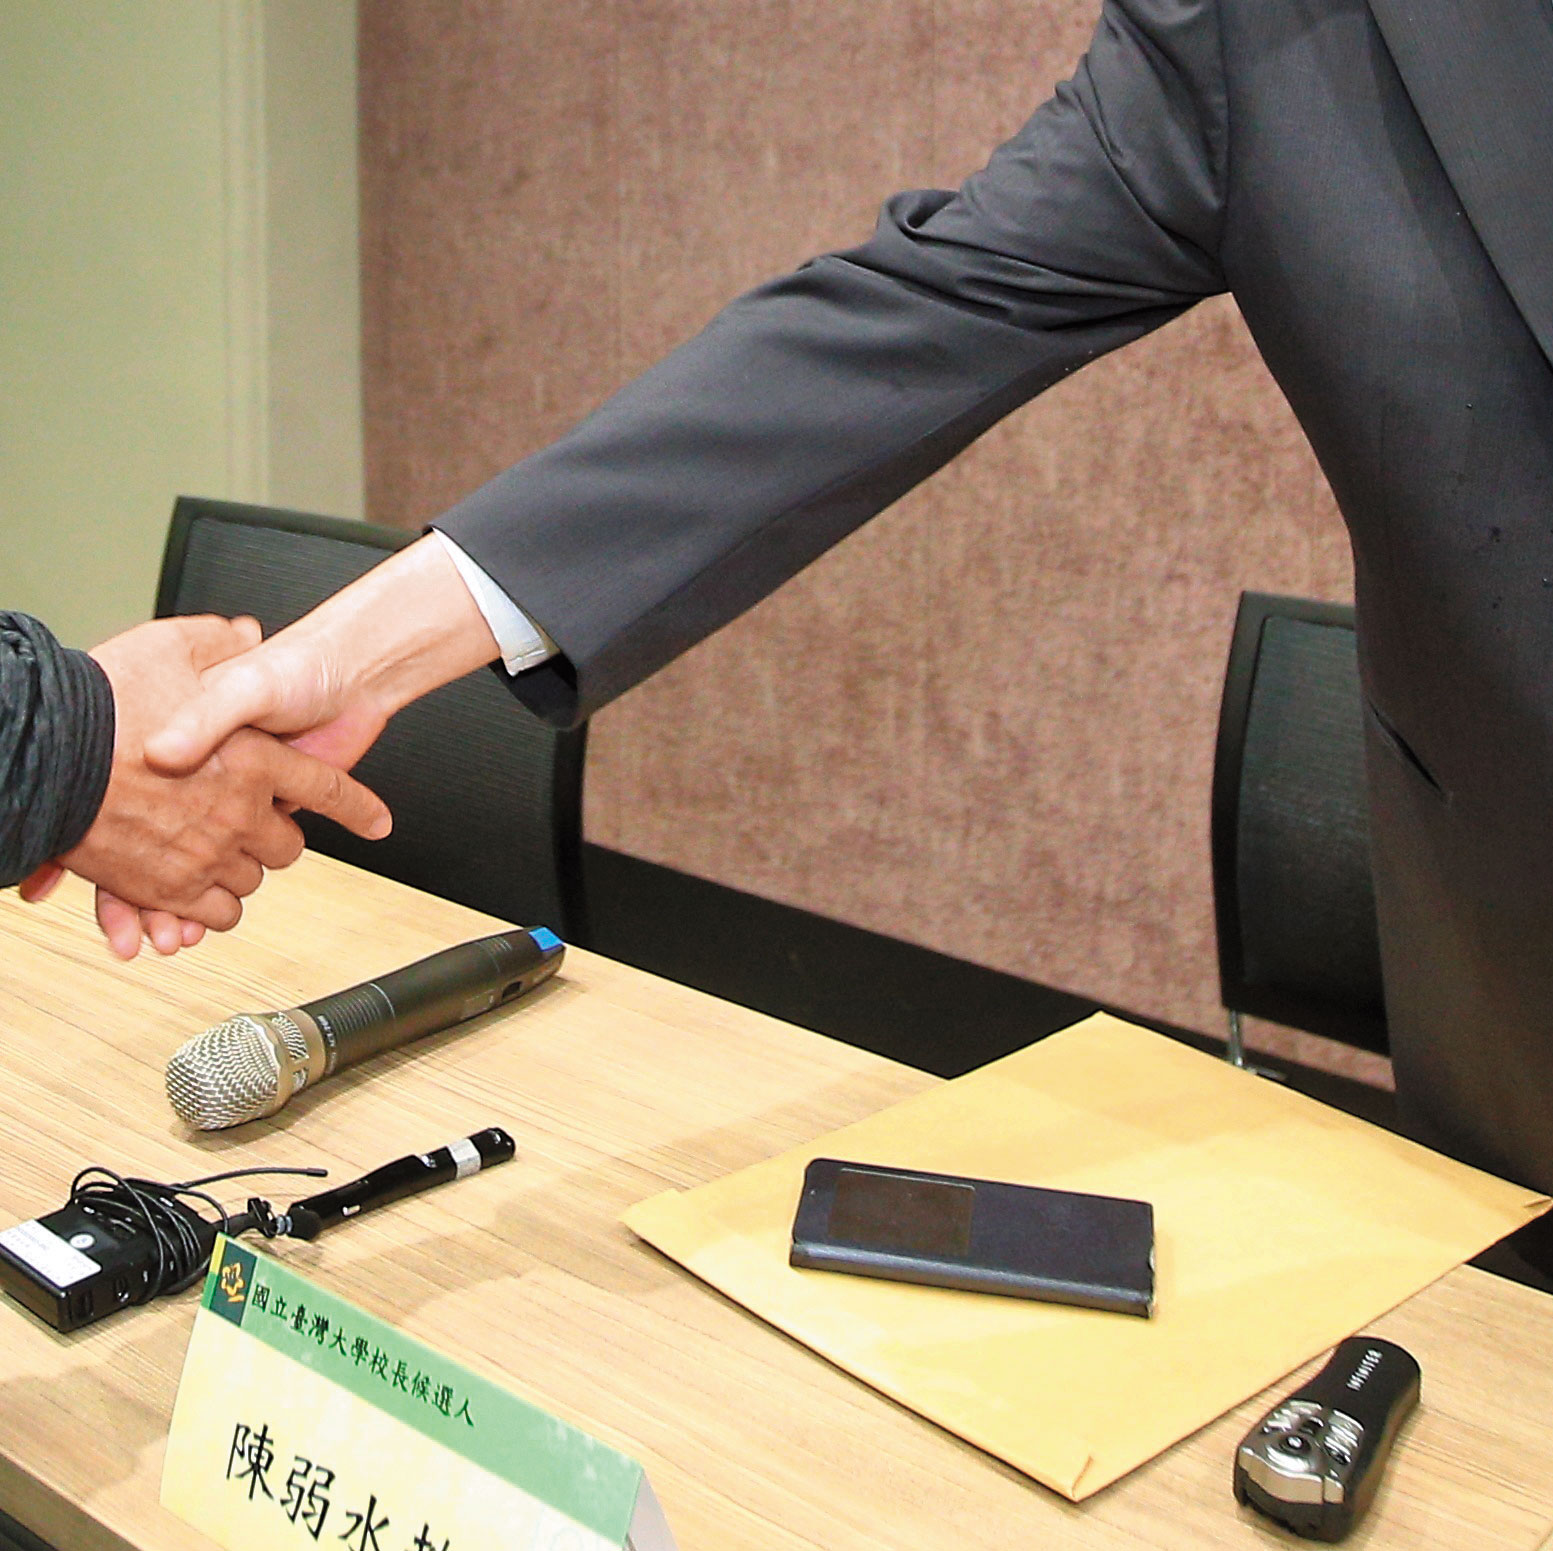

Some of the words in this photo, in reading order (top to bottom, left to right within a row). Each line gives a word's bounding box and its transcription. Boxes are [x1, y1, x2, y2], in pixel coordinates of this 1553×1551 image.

[251, 1282, 476, 1429] 國立臺灣大學校長候選人
